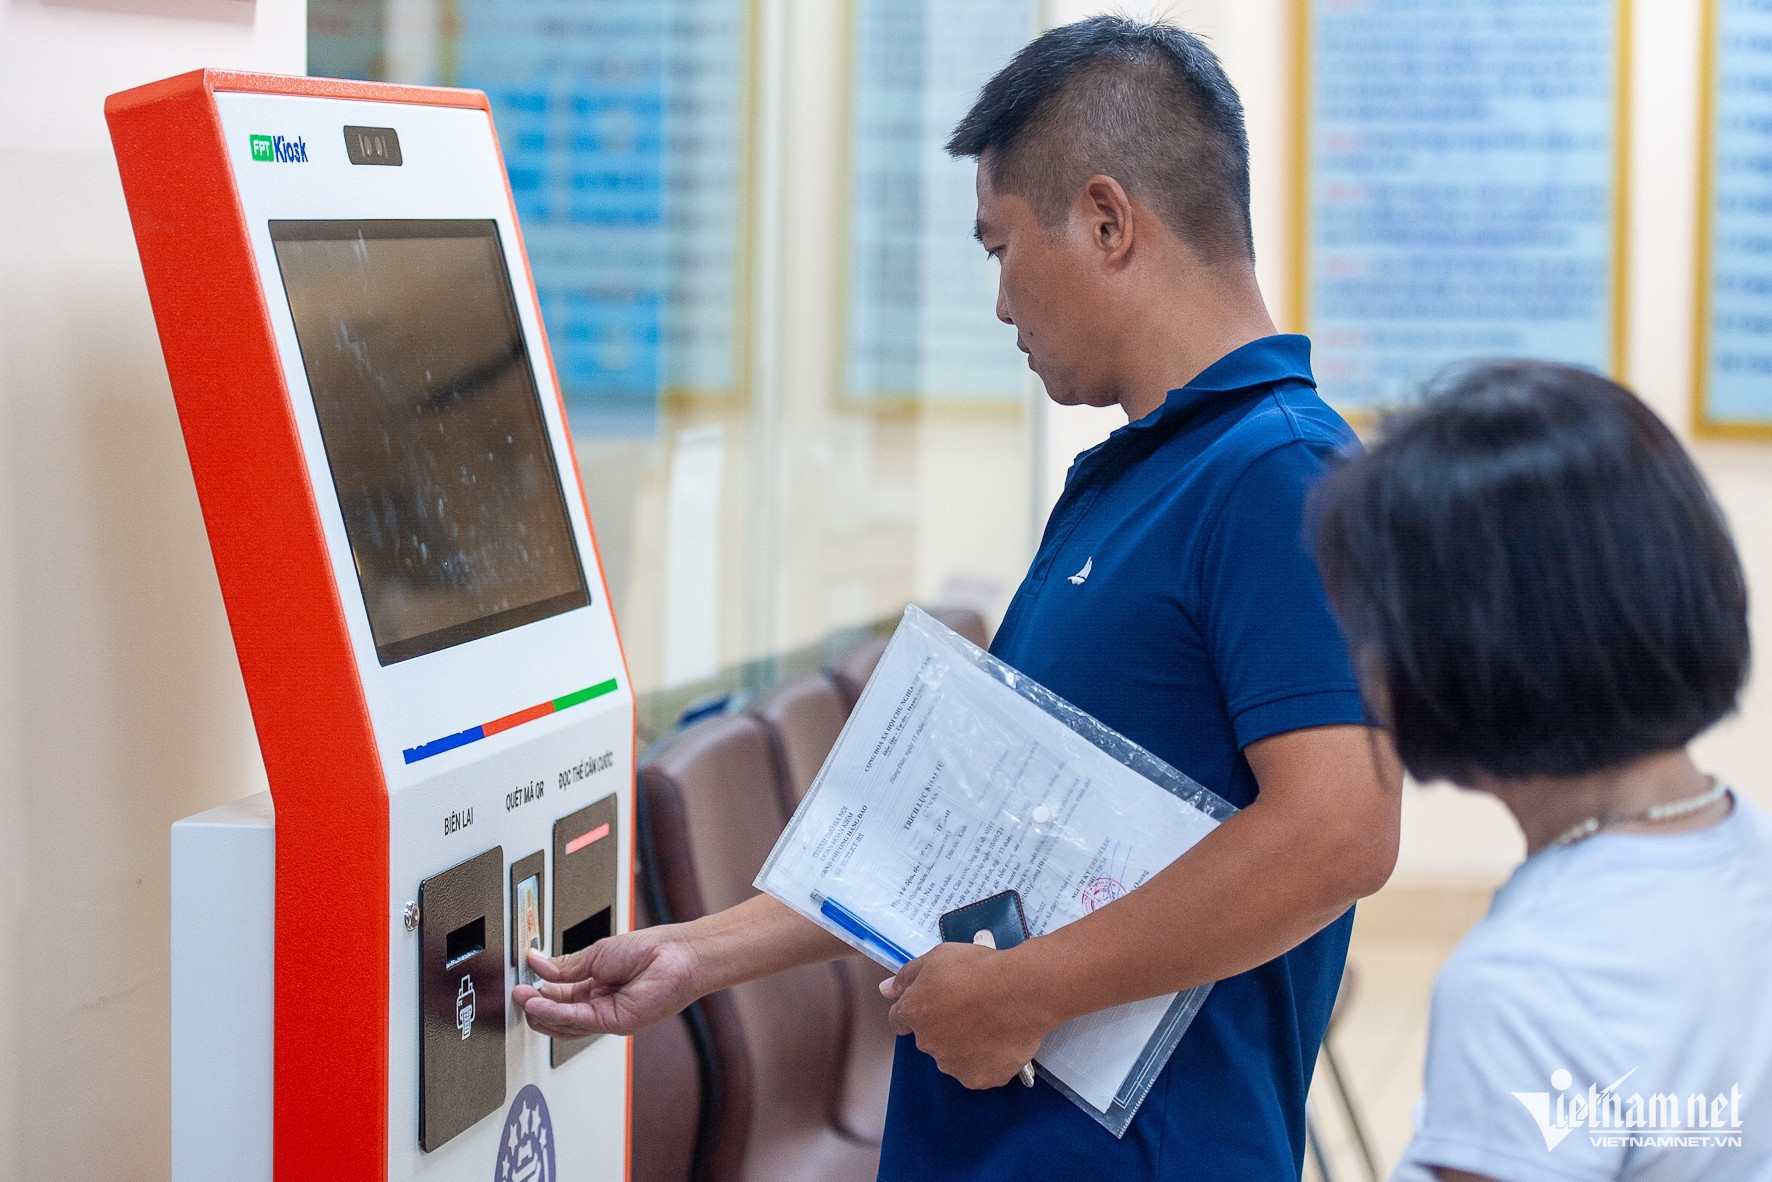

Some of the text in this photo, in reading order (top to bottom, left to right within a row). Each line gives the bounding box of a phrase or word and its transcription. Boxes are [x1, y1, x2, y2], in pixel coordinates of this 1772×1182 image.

[252, 135, 308, 163] FPT Kiosk
[558, 768, 572, 791] ĐỌC
[505, 781, 545, 813] QUÉT MÃ QR
[444, 807, 474, 836] BIÊN LAI
